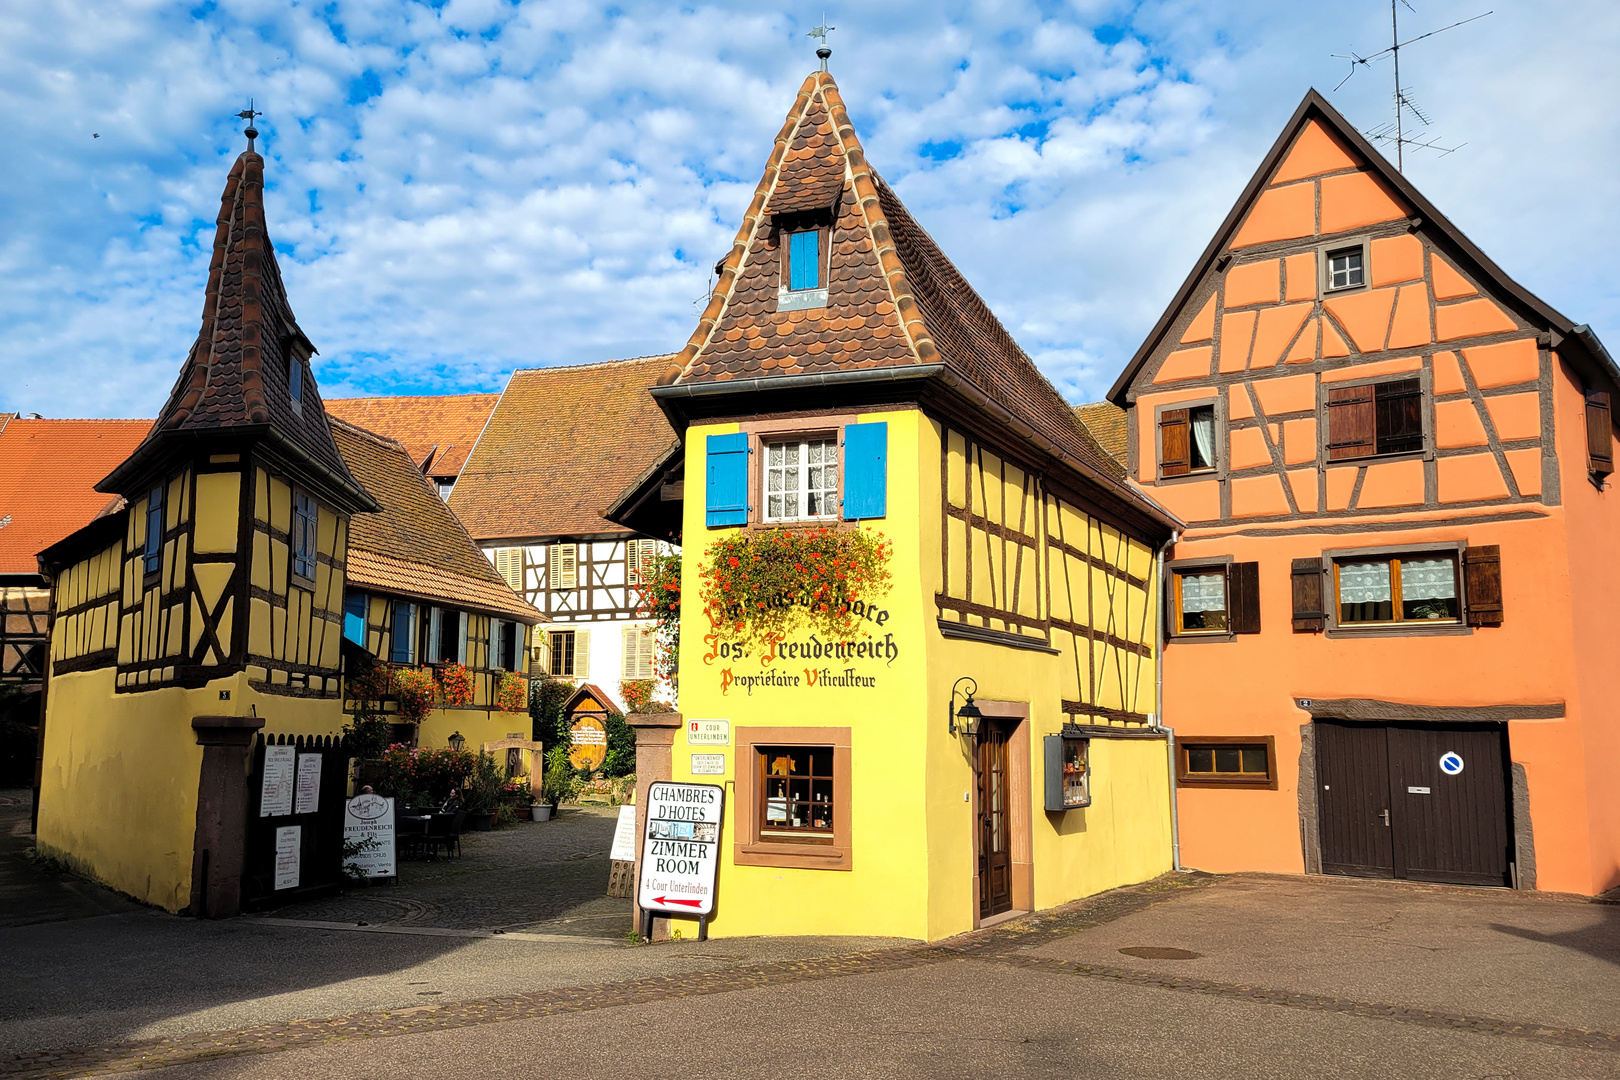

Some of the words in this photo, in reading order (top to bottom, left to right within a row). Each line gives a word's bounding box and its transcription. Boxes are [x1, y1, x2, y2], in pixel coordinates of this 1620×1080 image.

[703, 633, 750, 666] Jos.
[761, 629, 899, 669] Freudenreich
[720, 667, 800, 696] Propriétaire
[803, 667, 876, 688] Viticulteur
[653, 786, 715, 804] CHAMBRES
[658, 804, 706, 821] D'HOTES
[345, 824, 393, 832] FREUDENREICH
[650, 840, 708, 859] ZIMMER
[656, 858, 700, 875] ROOM
[646, 878, 650, 890] 4
[652, 878, 668, 892] Cour
[669, 880, 708, 895] Unterlinden
